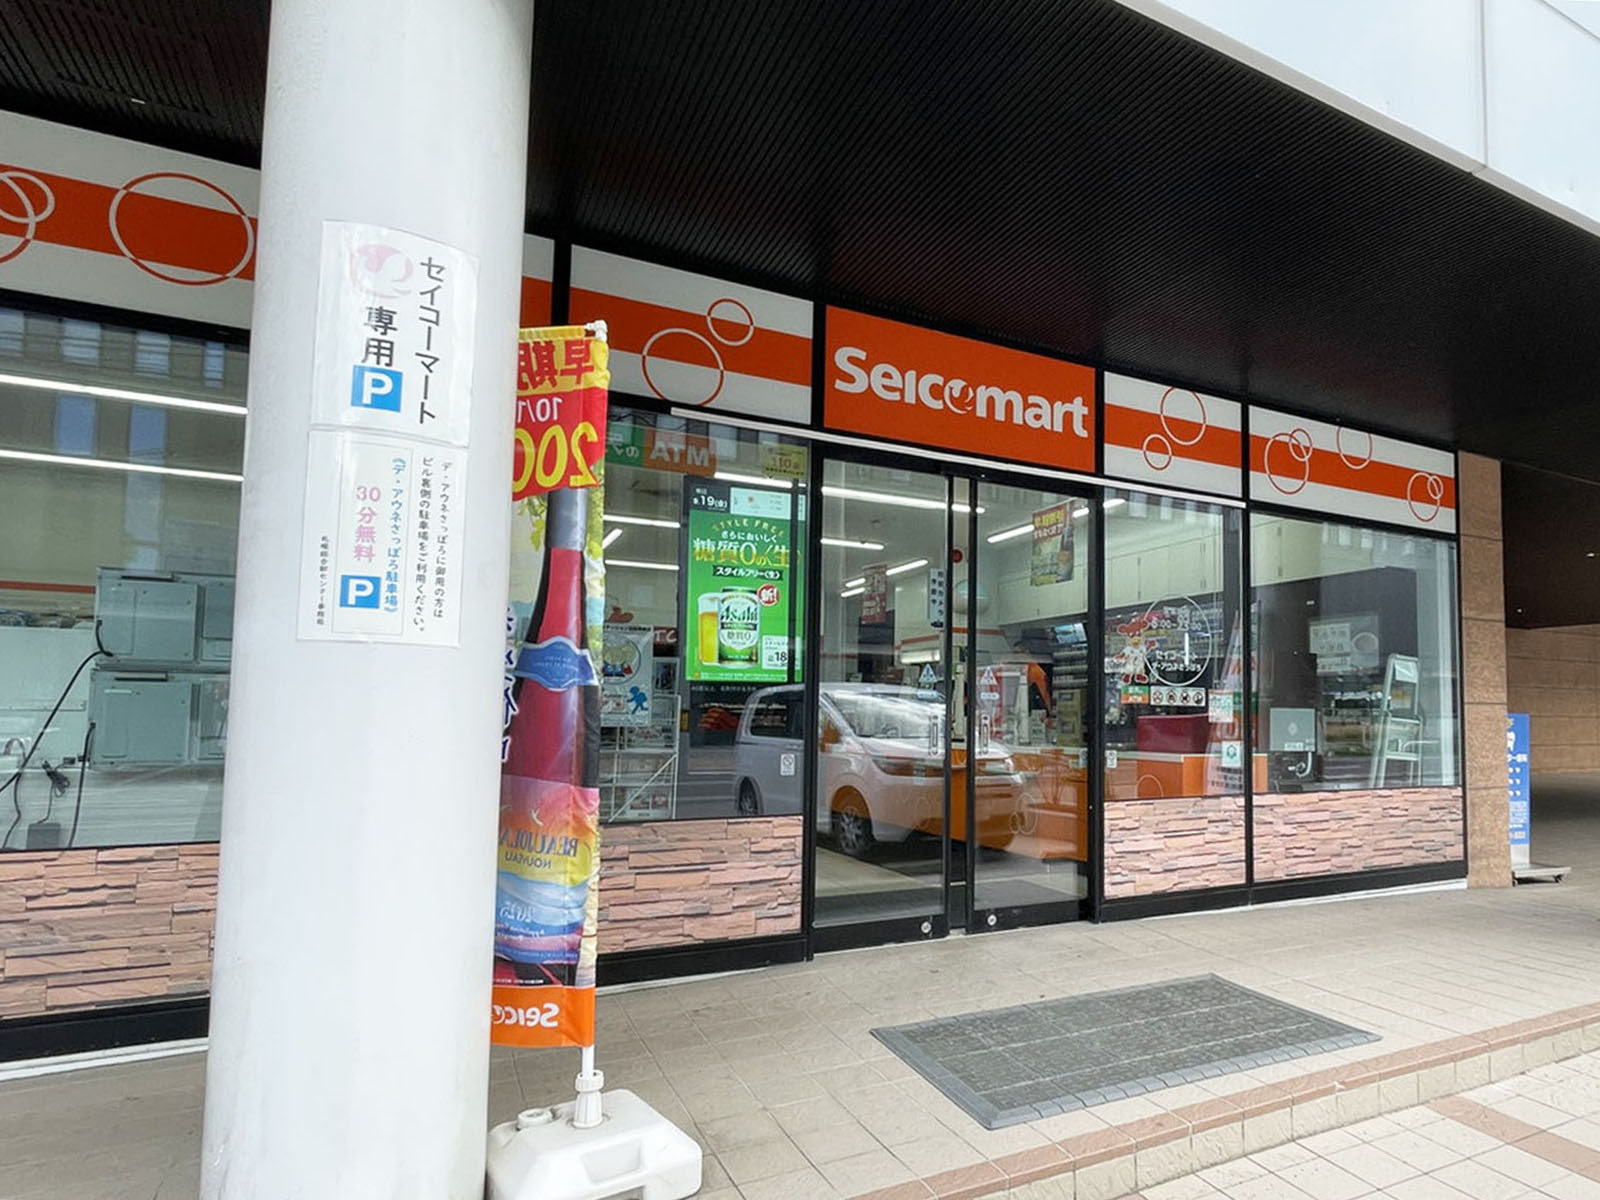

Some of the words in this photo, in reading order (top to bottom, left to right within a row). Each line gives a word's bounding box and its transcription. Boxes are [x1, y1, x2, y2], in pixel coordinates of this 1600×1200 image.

[361, 306, 398, 367] 専用
[415, 256, 446, 424] セイコーマート
[361, 370, 394, 406] P
[833, 346, 1089, 438] Seicomart
[650, 440, 710, 467] ATM
[354, 485, 381, 563] 30分無料
[347, 578, 374, 606] P
[721, 605, 758, 622] Asahi
